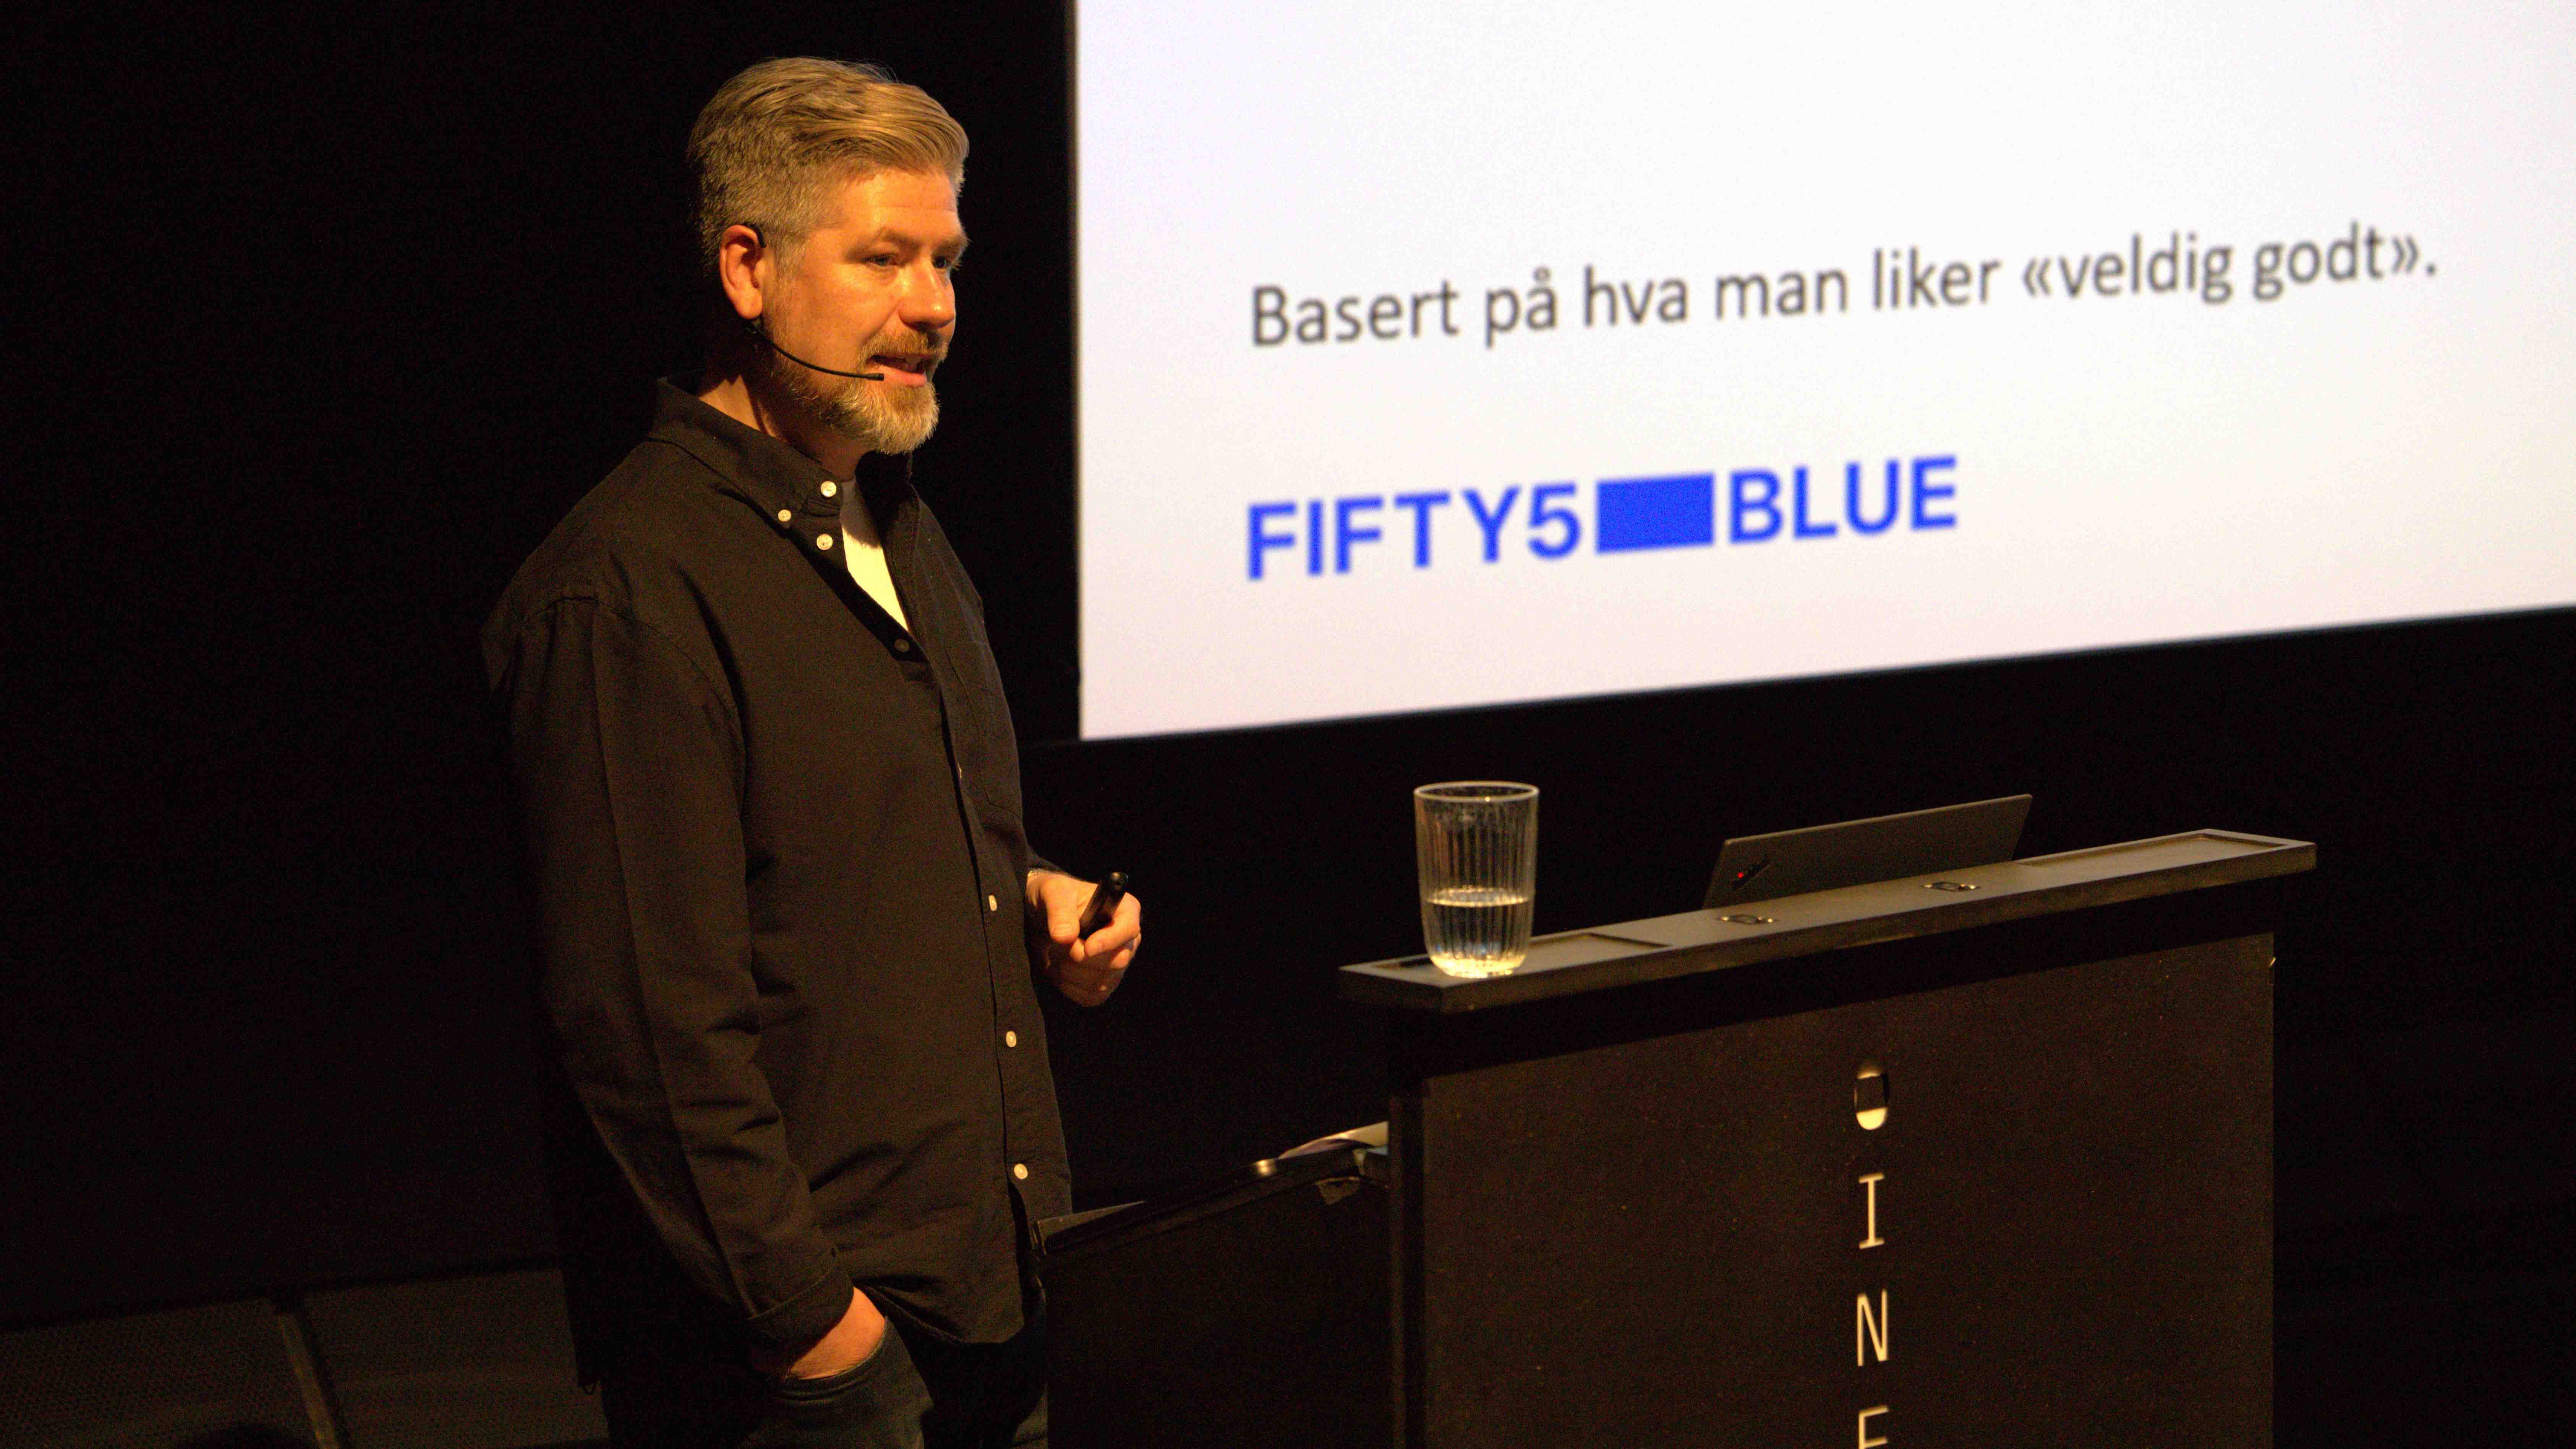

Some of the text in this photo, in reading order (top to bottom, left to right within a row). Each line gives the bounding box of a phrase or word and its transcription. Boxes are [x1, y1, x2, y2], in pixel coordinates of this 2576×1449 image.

[1252, 223, 2436, 348] Basert på hva man liker «veldig godt».
[1247, 455, 1957, 581] FIFTY5 BLUE
